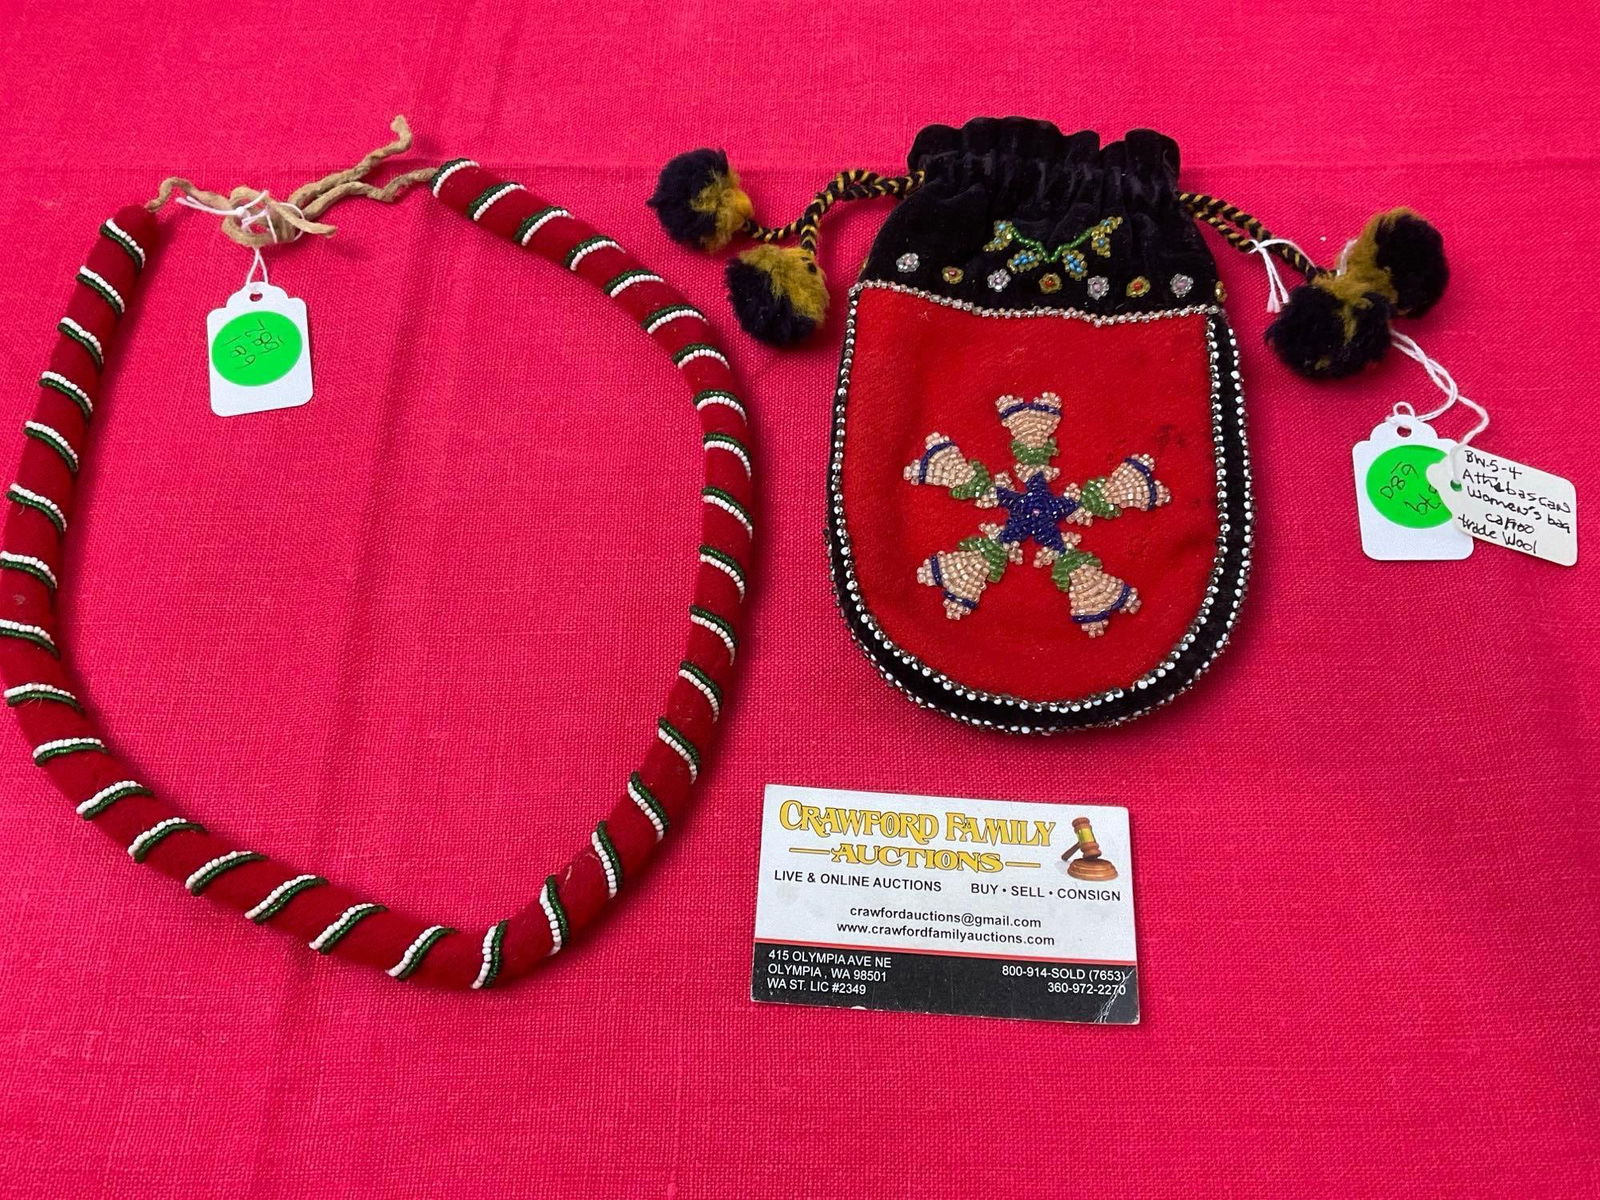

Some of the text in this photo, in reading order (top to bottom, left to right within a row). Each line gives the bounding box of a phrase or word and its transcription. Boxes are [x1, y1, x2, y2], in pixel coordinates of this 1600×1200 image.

[1457, 513, 1498, 539] trade
[1547, 513, 1571, 534] bag
[779, 799, 1057, 847] CRAWFORD FAMILY
[830, 843, 1004, 874] AUCTIONS
[774, 869, 942, 892] LIVE & ONLINE AUCTIONS
[970, 882, 1121, 902] BUY SELL CONSIGN
[849, 906, 1042, 928] crawfordauctions@gmail.com
[836, 921, 1055, 946] www.crawfordfamilyauctions.com
[768, 949, 892, 968] 415 OLYMPIA AVE NE
[830, 968, 851, 980] WA
[853, 969, 887, 982] 98501
[1001, 965, 1126, 982] 800-914-SOLD (7653)
[766, 977, 867, 995] WA ST. LIC #2349
[1047, 981, 1127, 996] 360-972-2270
